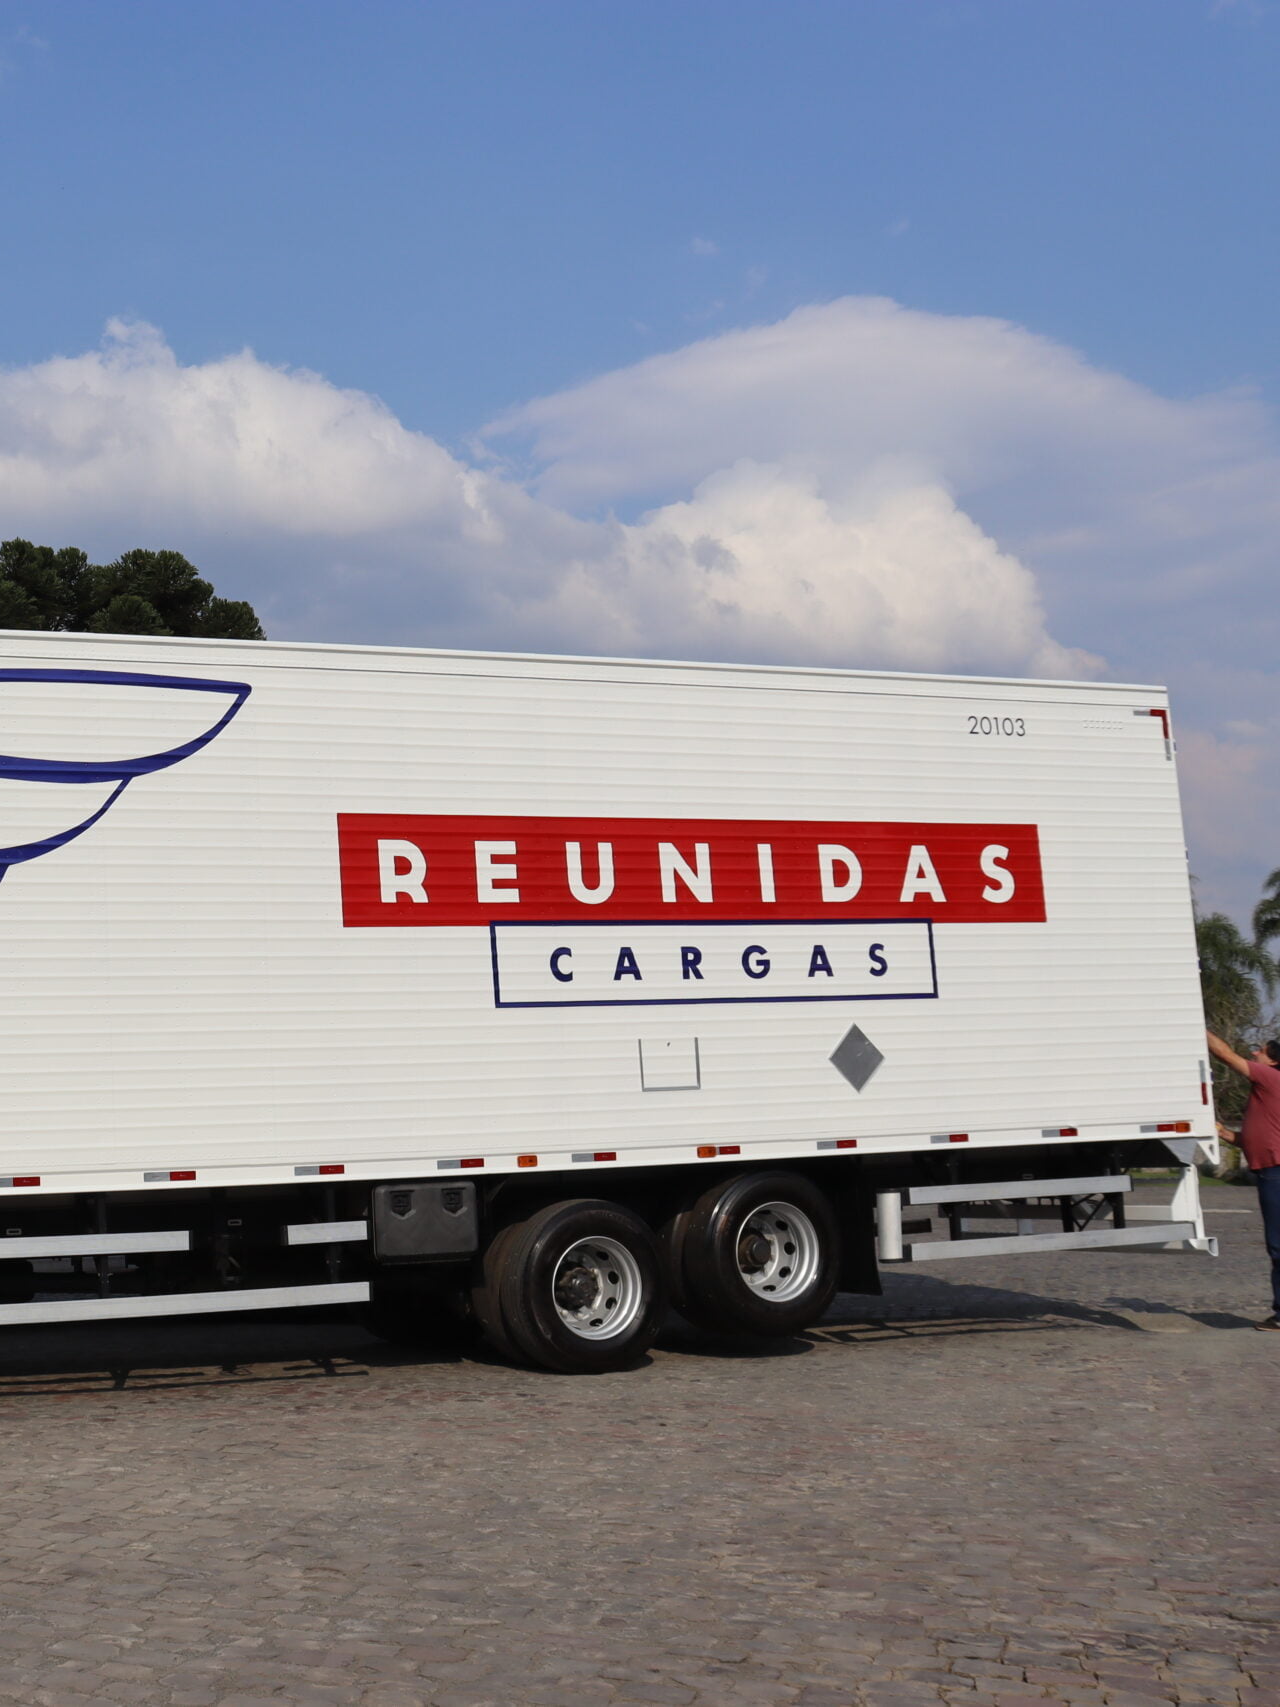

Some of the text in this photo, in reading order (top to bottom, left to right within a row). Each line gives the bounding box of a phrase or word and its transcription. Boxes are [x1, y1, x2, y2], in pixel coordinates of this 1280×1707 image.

[968, 716, 1025, 736] 20103
[377, 839, 1016, 904] REUNIDAS
[549, 944, 888, 983] CARGAS
